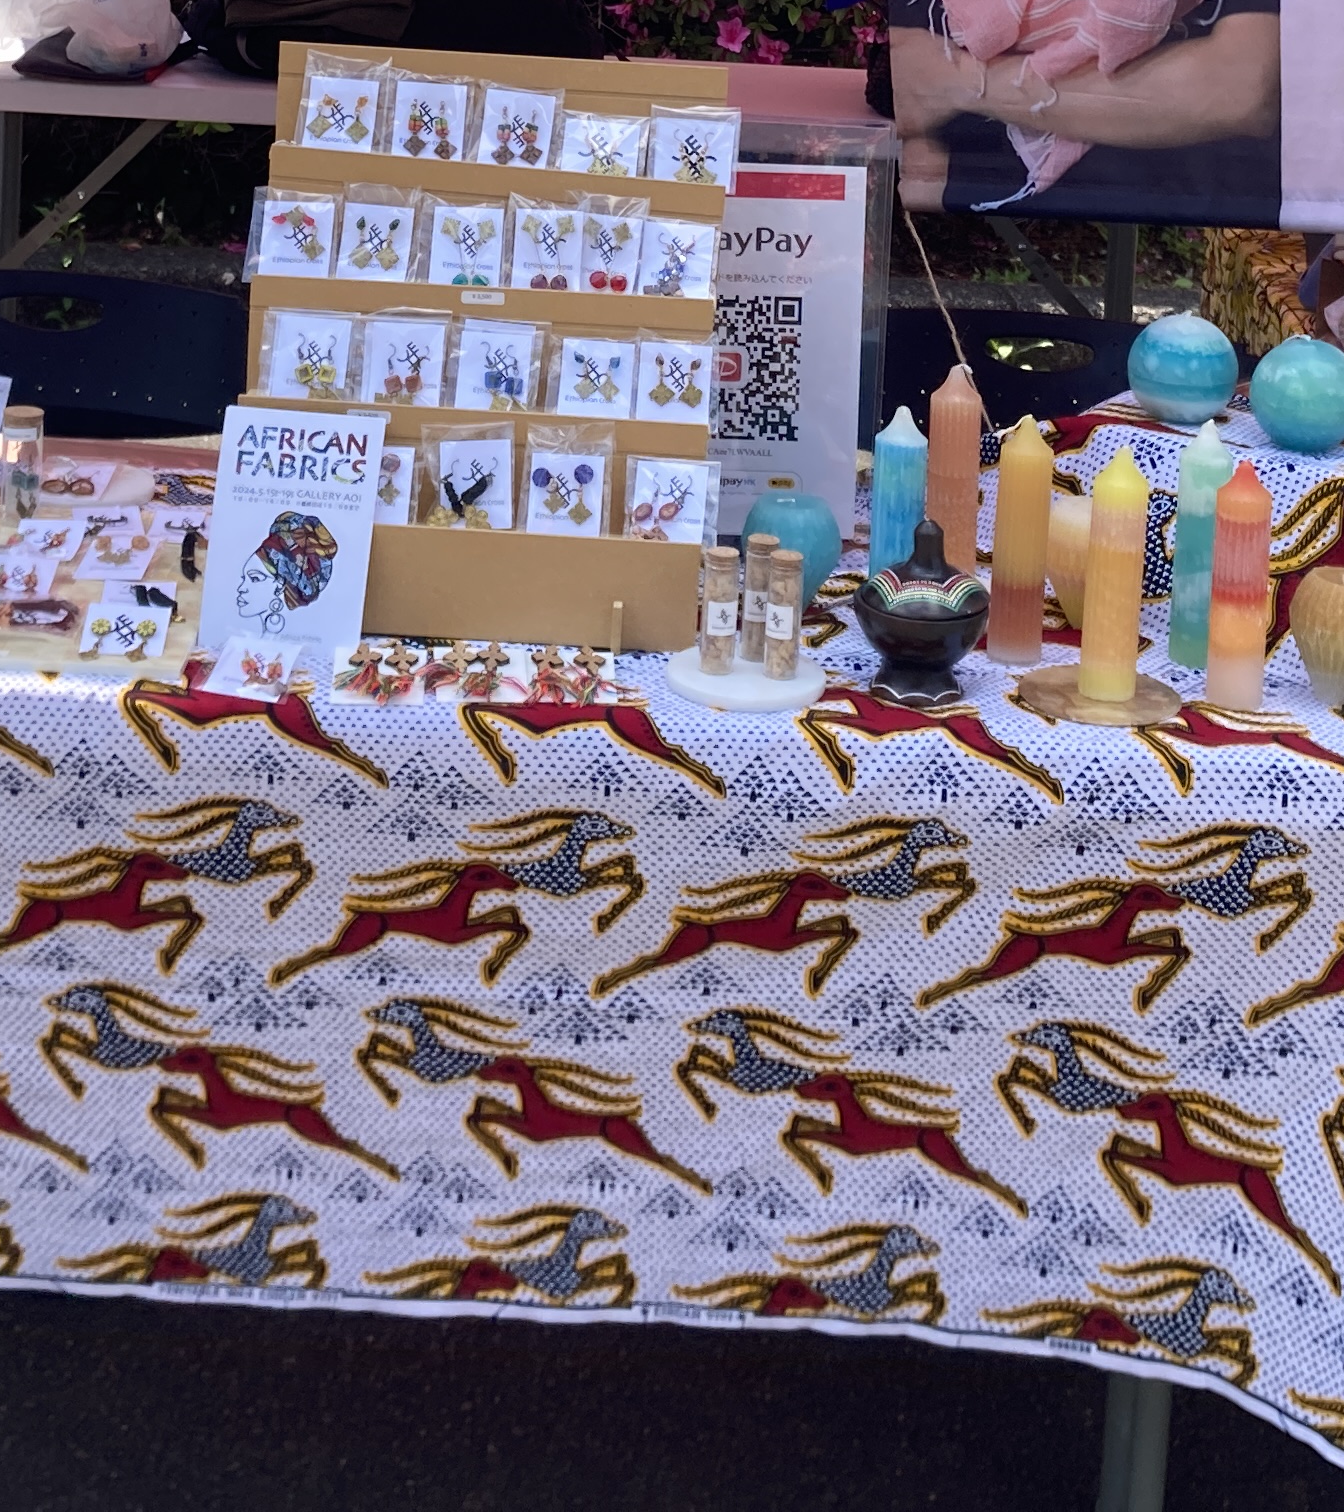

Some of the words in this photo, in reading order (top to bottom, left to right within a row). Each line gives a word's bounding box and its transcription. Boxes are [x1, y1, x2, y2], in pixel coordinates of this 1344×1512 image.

[719, 226, 813, 259] ayPay
[236, 423, 369, 458] AFRICAN
[234, 448, 368, 486] FABRICS
[296, 489, 342, 502] GALLERY
